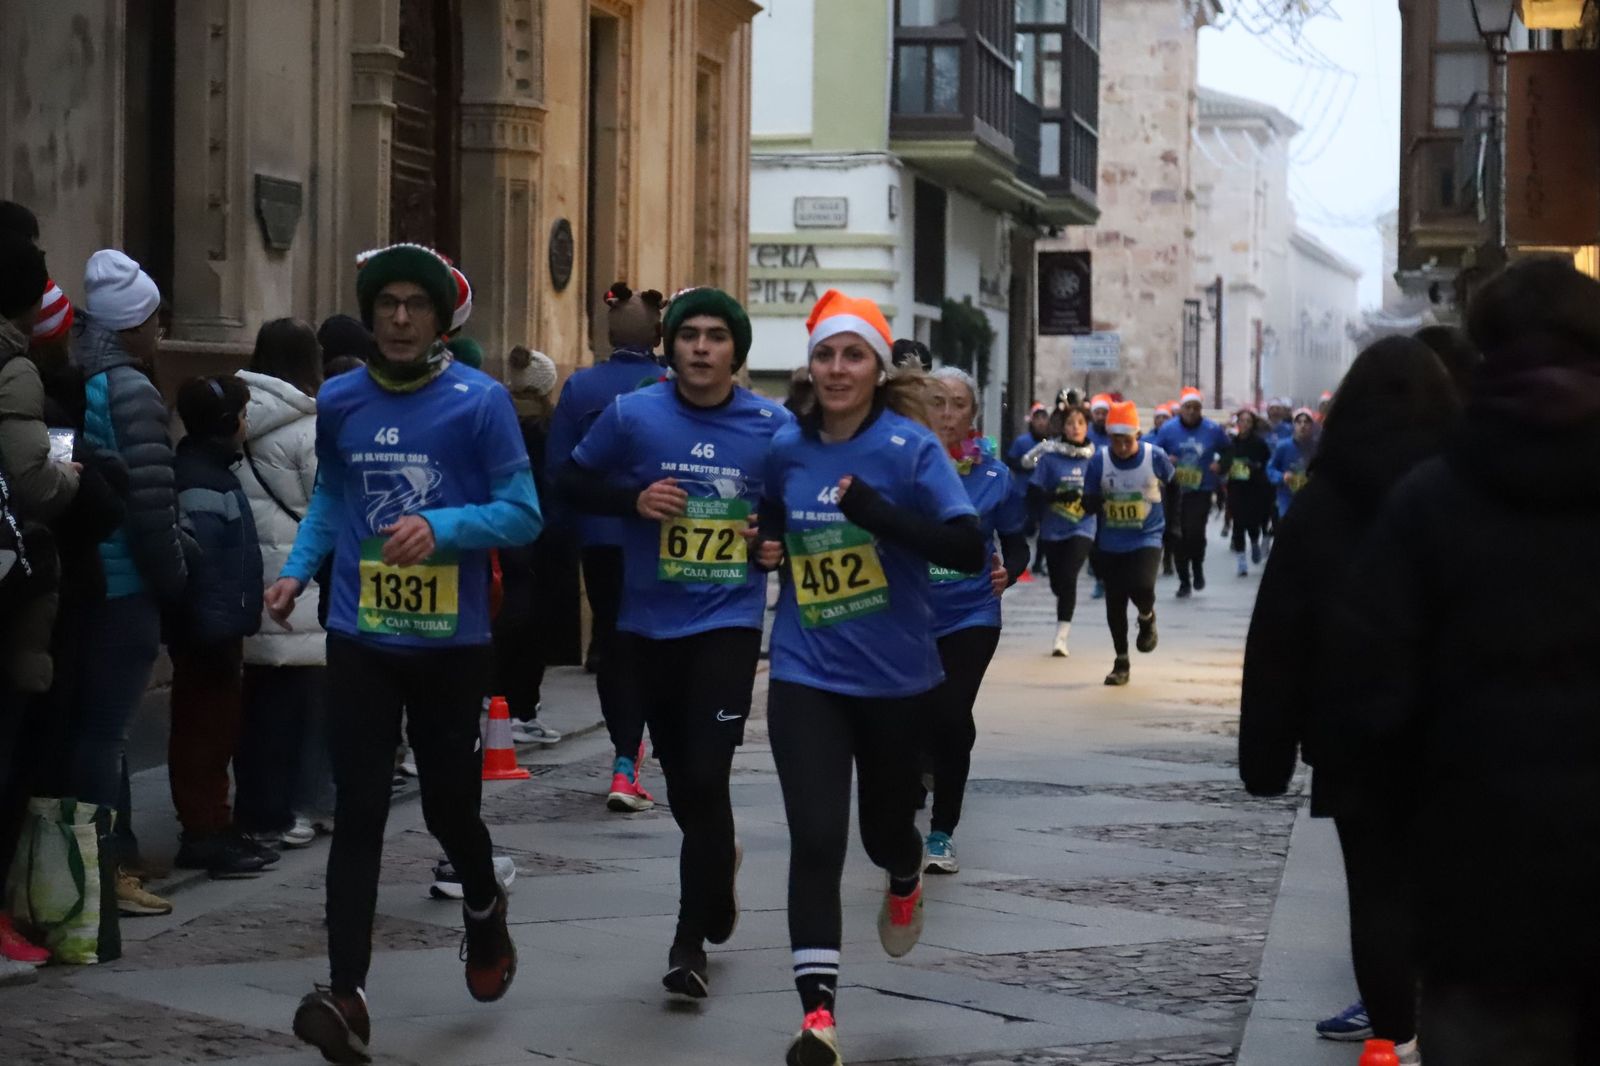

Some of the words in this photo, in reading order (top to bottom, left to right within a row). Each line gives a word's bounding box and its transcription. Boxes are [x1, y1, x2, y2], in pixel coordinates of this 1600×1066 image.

[374, 427, 400, 446] 46
[364, 453, 405, 462] SILVESTRE
[690, 442, 715, 459] 46
[661, 462, 676, 471] SAN
[678, 463, 720, 475] SILVESTRE
[668, 525, 735, 561] 672
[683, 568, 708, 577] CAJA
[710, 568, 743, 578] RURAL
[801, 554, 870, 597] 462
[929, 567, 949, 575] CAJA
[370, 572, 438, 613] 1331
[822, 605, 847, 619] CAJA
[849, 595, 887, 611] RURAL
[386, 616, 411, 629] CAJA
[413, 618, 451, 631] RURAL
